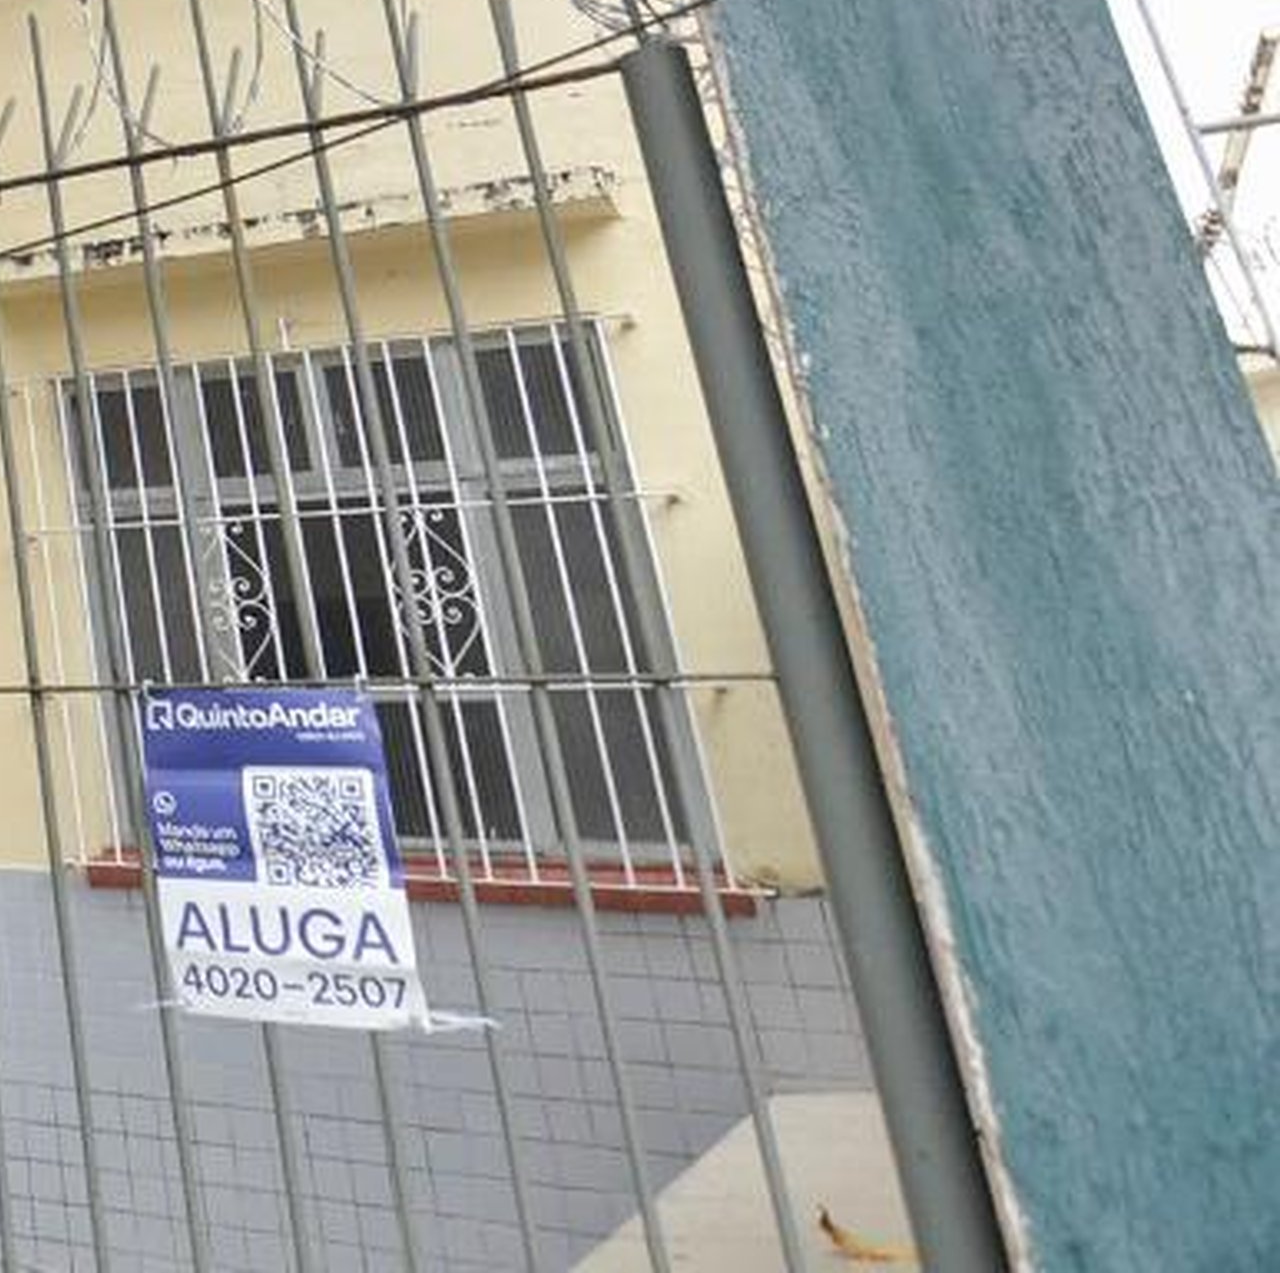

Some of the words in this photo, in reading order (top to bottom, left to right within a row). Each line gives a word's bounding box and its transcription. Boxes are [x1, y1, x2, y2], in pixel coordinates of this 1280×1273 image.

[176, 701, 360, 729] QuintoAndar
[177, 901, 399, 964] ALUGA
[183, 963, 406, 1008] 4020-2507
